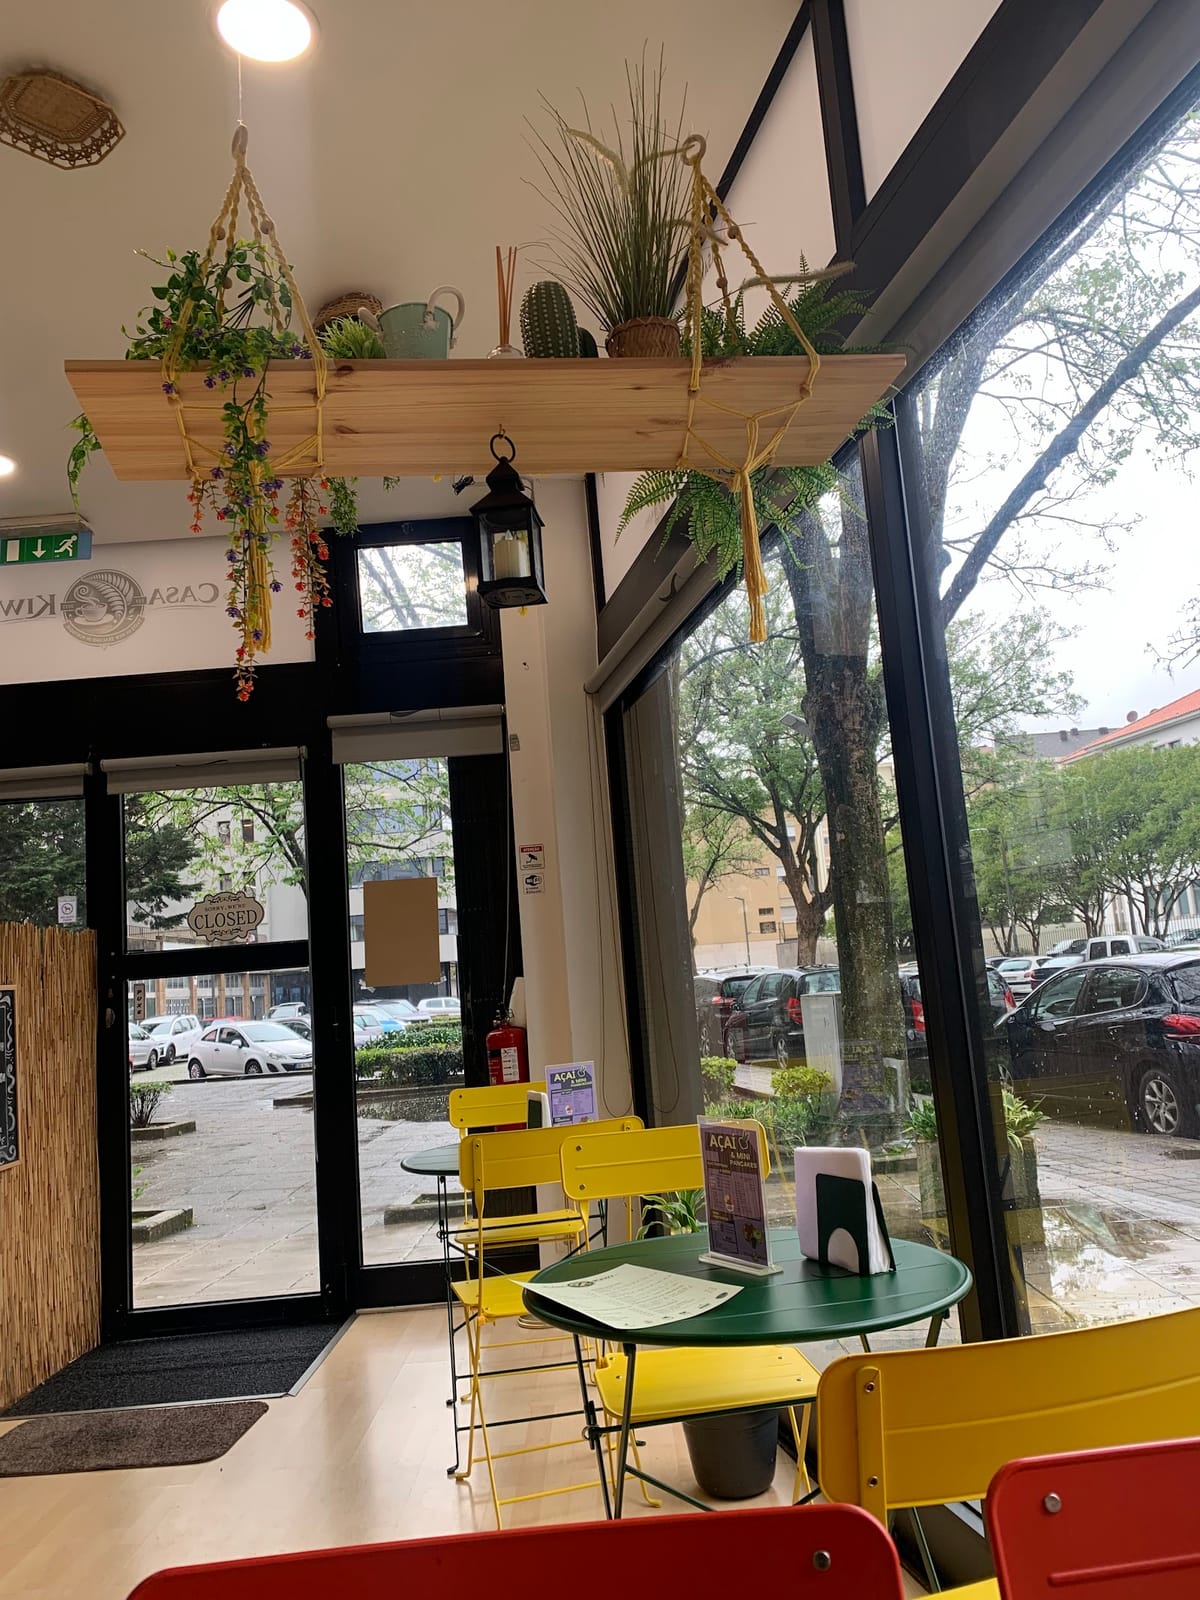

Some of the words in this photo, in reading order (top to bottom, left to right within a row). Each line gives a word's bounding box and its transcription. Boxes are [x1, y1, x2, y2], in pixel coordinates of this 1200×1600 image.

[194, 910, 257, 930] CLOSED
[736, 1152, 751, 1160] MINI
[729, 1160, 758, 1168] PANCAKES
